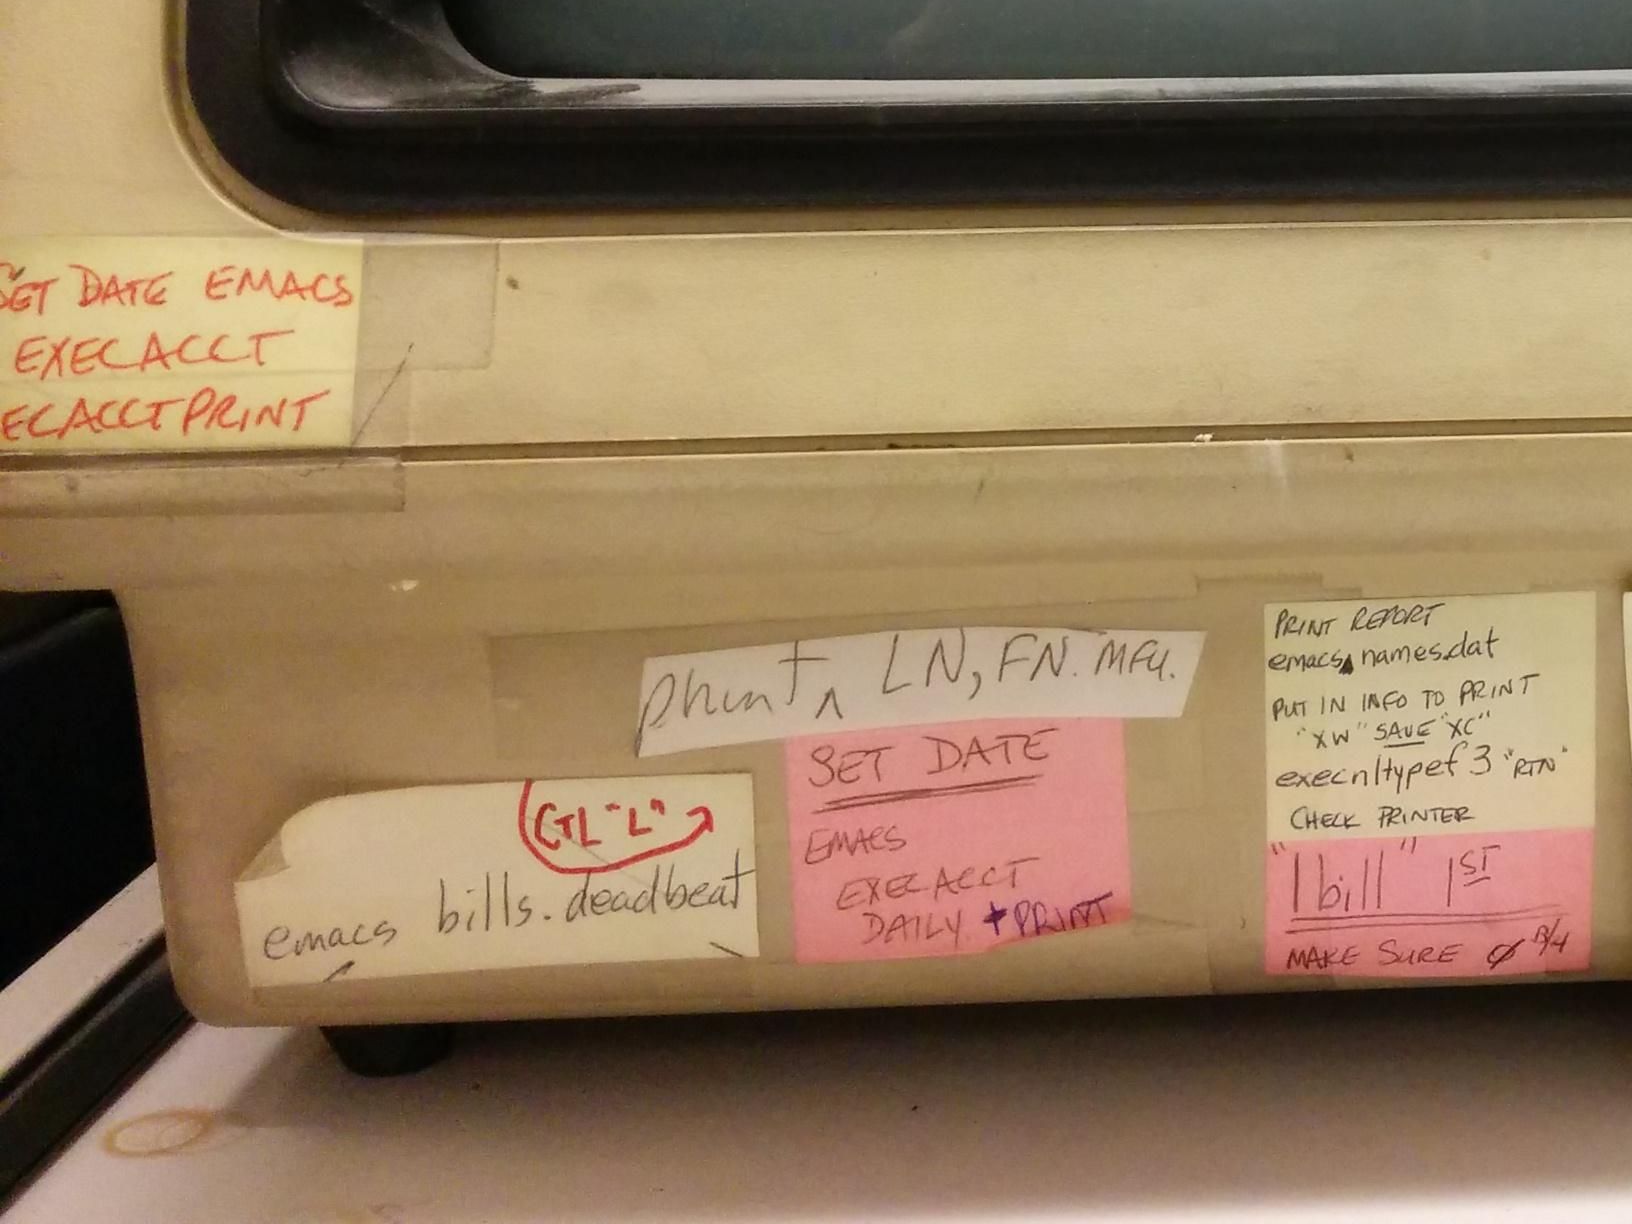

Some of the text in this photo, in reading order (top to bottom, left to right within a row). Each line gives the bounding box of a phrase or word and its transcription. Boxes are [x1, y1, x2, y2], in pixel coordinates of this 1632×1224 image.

[67, 264, 174, 307] DATE
[204, 266, 354, 308] EMACS
[14, 329, 295, 381] EXECACCT
[1274, 603, 1445, 639] PRINT REPORT
[1321, 696, 1345, 713] IN
[1362, 692, 1408, 711] INFO
[1422, 689, 1445, 710] TO
[1459, 673, 1540, 705] PRINT
[1374, 719, 1437, 740] SAVE
[808, 728, 1061, 788] SET DATE
[533, 801, 601, 850] CTL
[1290, 806, 1475, 830] CHECK PRINTER
[263, 848, 755, 960] emacs bills.deadbeat
[862, 910, 961, 945] DAILY
[1287, 945, 1361, 969] MAKE
[1378, 939, 1463, 966] SURE
